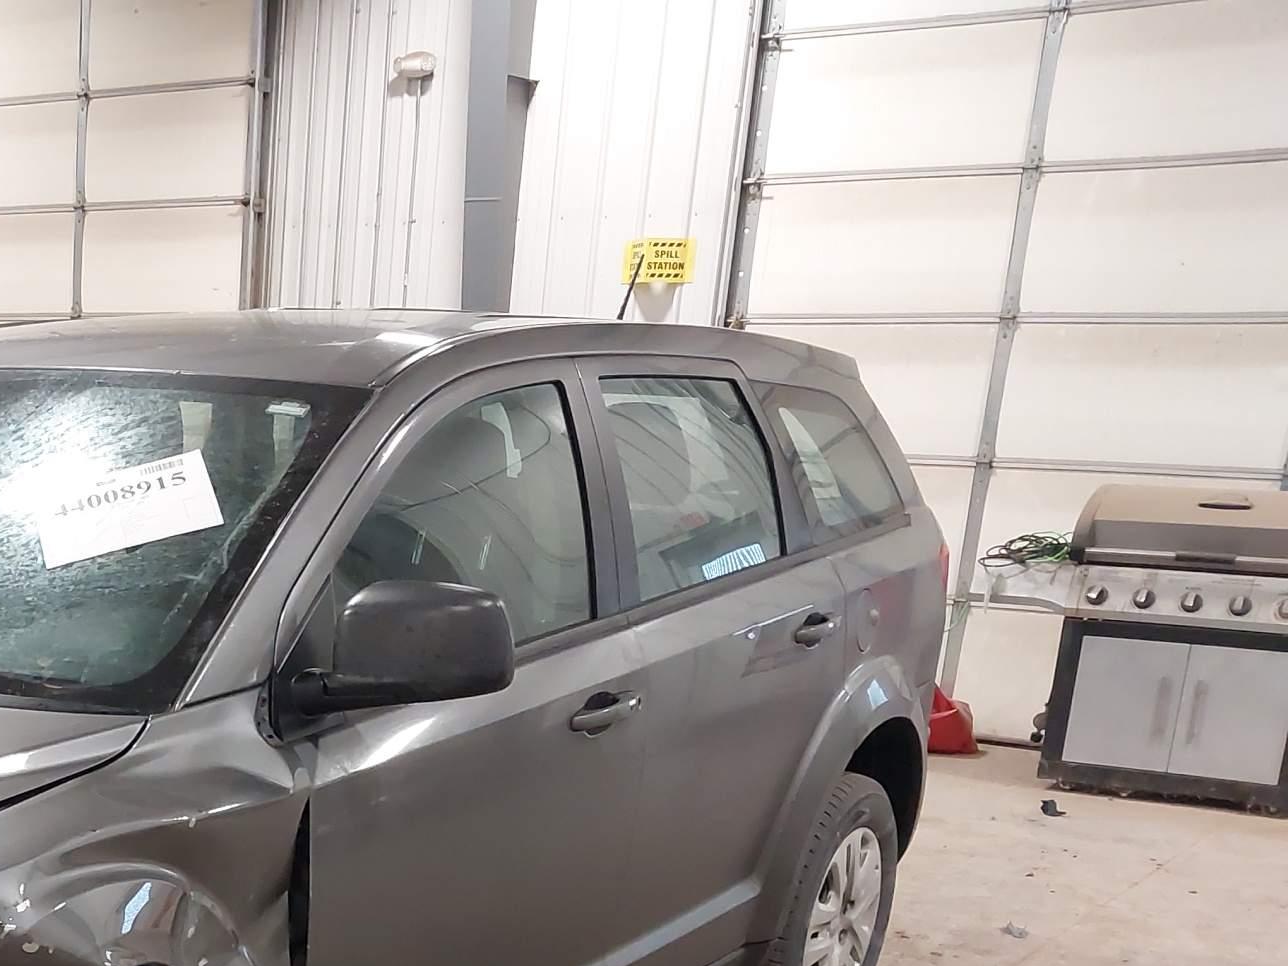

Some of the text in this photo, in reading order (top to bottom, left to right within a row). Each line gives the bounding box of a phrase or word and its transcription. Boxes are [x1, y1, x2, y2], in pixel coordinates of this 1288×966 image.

[654, 250, 680, 259] SPILL
[646, 261, 685, 270] STATION
[54, 470, 187, 517] 44008915
